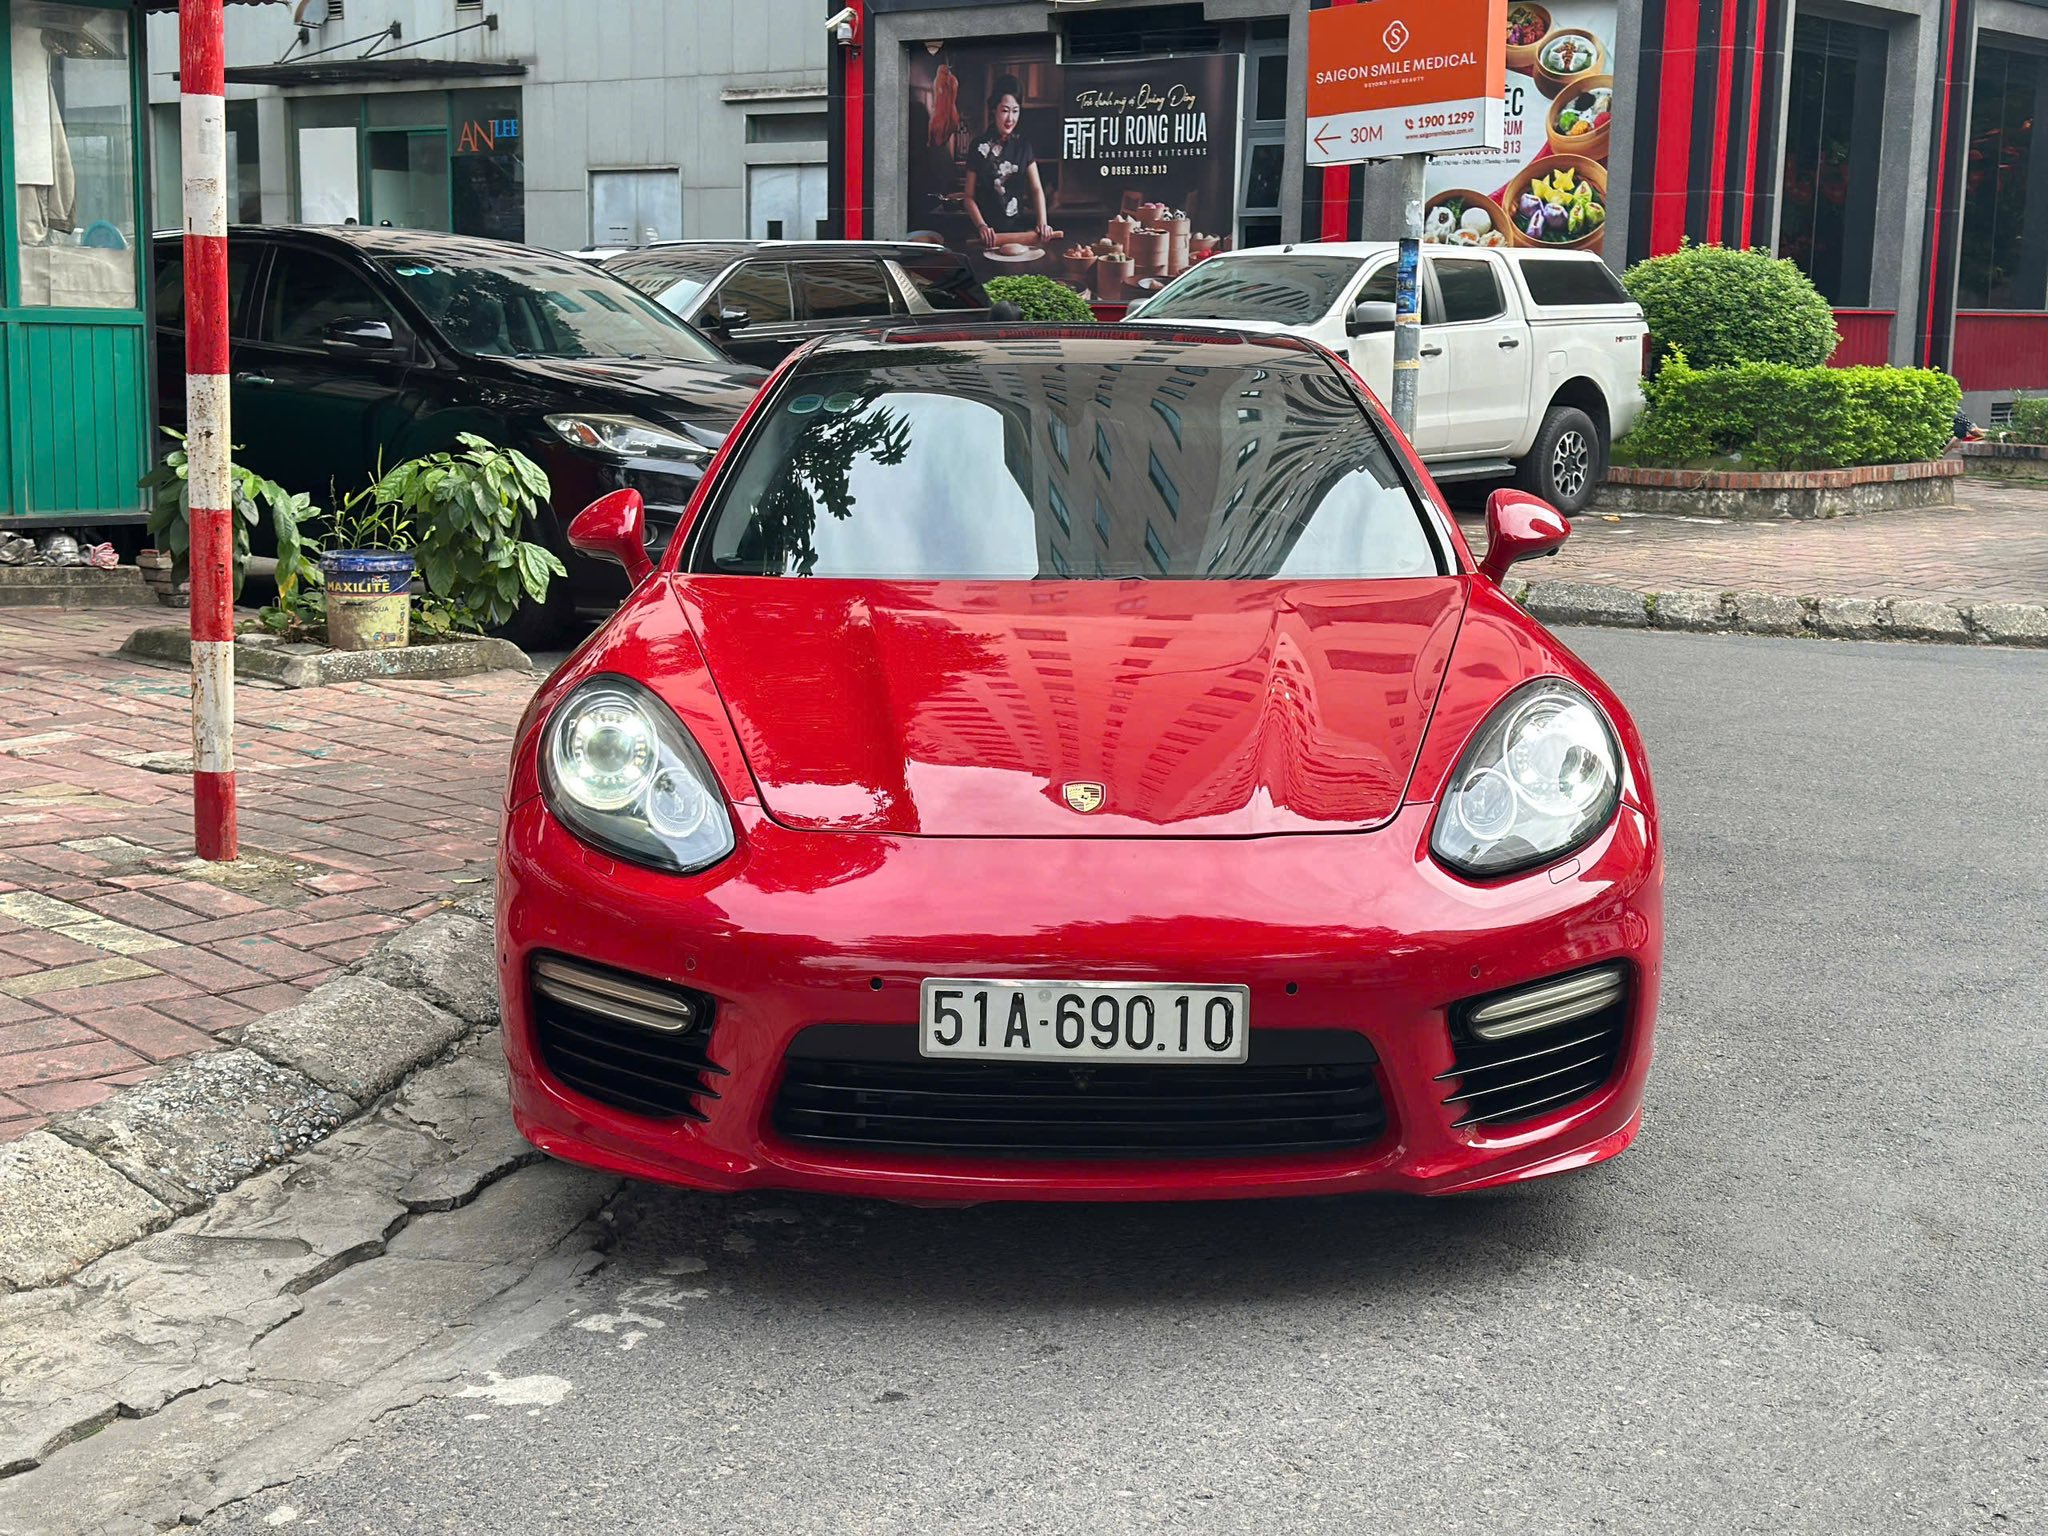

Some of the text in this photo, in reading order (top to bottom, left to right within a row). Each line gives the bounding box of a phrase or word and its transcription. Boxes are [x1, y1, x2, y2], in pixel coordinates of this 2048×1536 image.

[1316, 52, 1477, 85] SAIGON SMILE MEDICAL
[1401, 76, 1424, 84] BEAUTY
[1100, 116, 1119, 146] FU
[1125, 114, 1169, 145] RONG
[1174, 112, 1207, 143] HUA
[1418, 111, 1475, 129] 1900 1299
[1350, 125, 1383, 144] 30M
[1099, 148, 1207, 158] CANTONESE KITCHENS
[327, 582, 390, 593] MAXILITE
[934, 990, 1235, 1052] 51A-690.10
